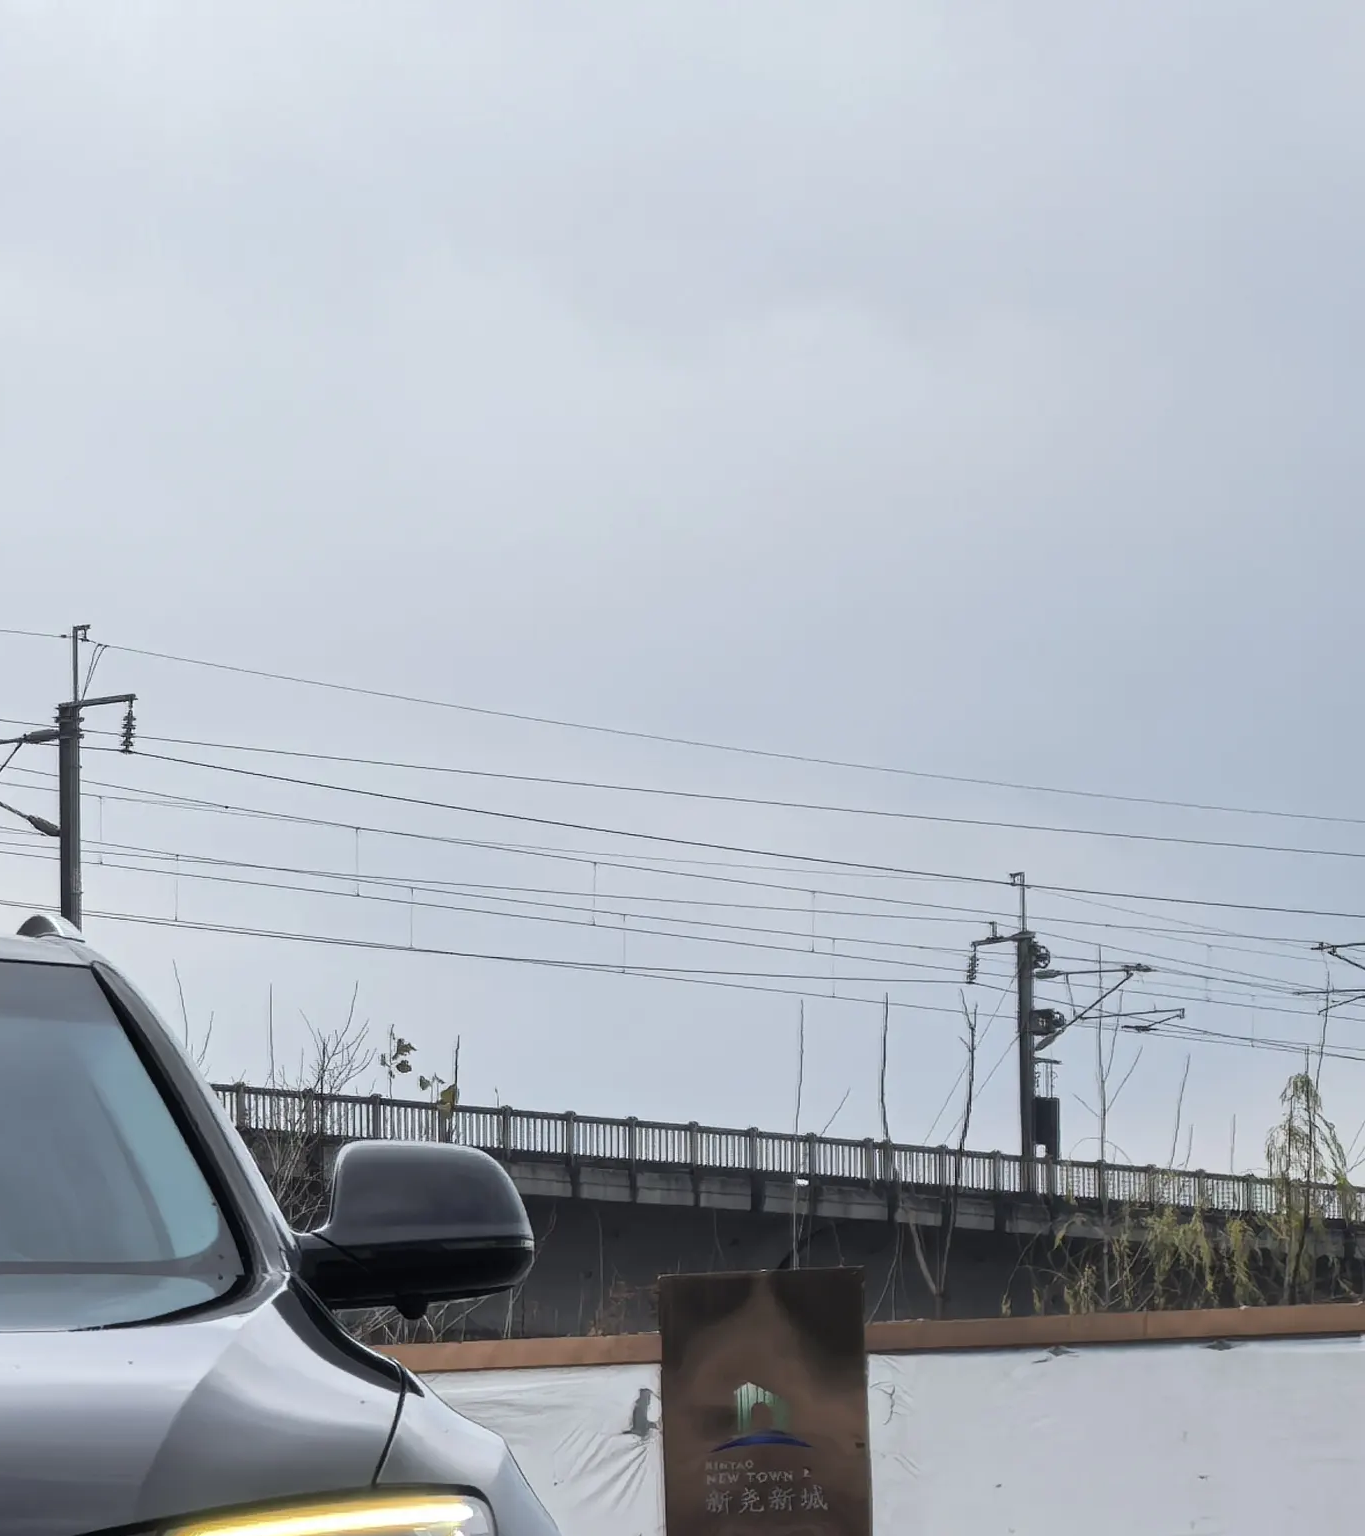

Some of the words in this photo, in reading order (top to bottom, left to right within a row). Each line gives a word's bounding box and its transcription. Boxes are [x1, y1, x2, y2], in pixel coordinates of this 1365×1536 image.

[706, 1472, 740, 1485] NEW
[746, 1471, 793, 1483] TOWN
[706, 1484, 828, 1514] 新尧新城
